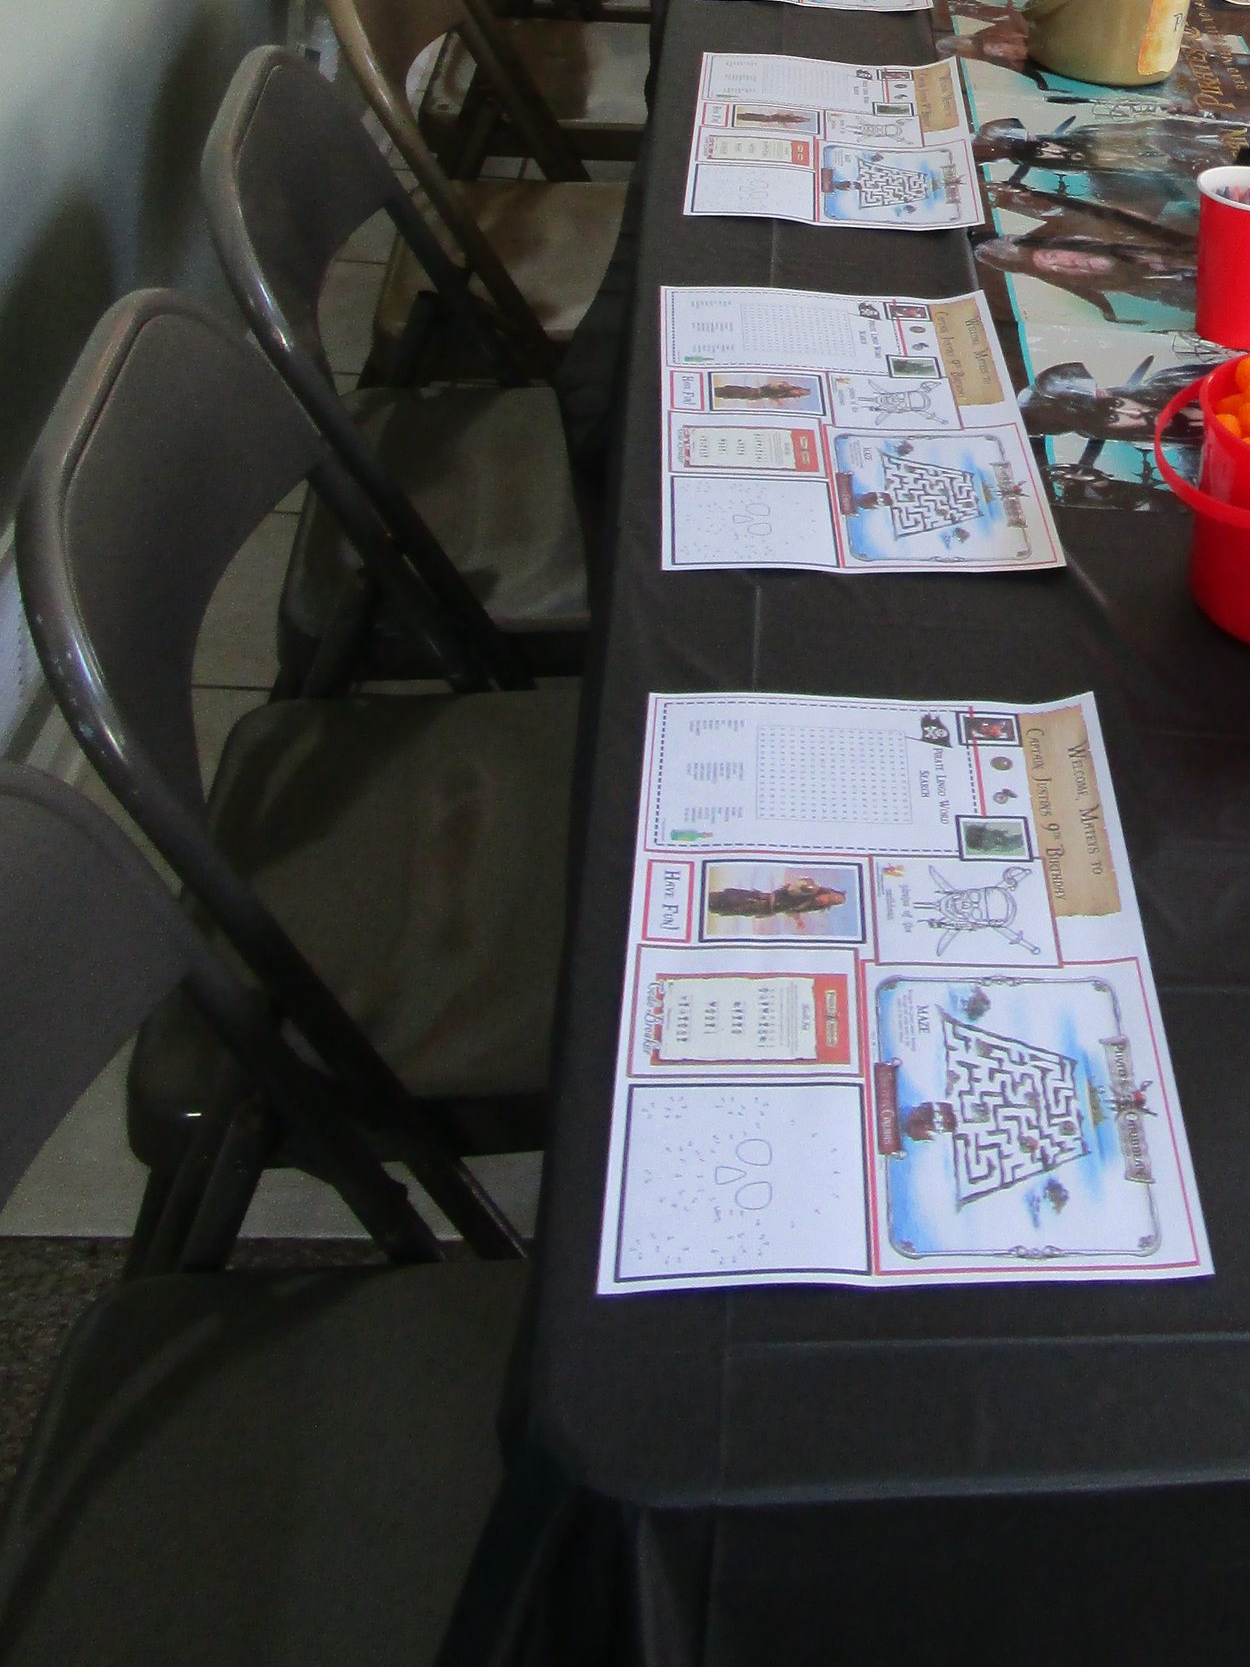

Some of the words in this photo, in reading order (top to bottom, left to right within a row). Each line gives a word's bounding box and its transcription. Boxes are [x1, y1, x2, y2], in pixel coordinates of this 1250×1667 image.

[933, 748, 944, 772] PIRATE
[919, 770, 930, 798] SEARCH
[935, 775, 947, 796] LINGO
[939, 800, 950, 824] WORD
[1027, 727, 1045, 770] CAPTAIN
[1045, 843, 1067, 901] BIRTHDAY
[1079, 804, 1100, 855] MATEYS
[664, 869, 681, 898] HAVE
[917, 1004, 930, 1035] MAZE
